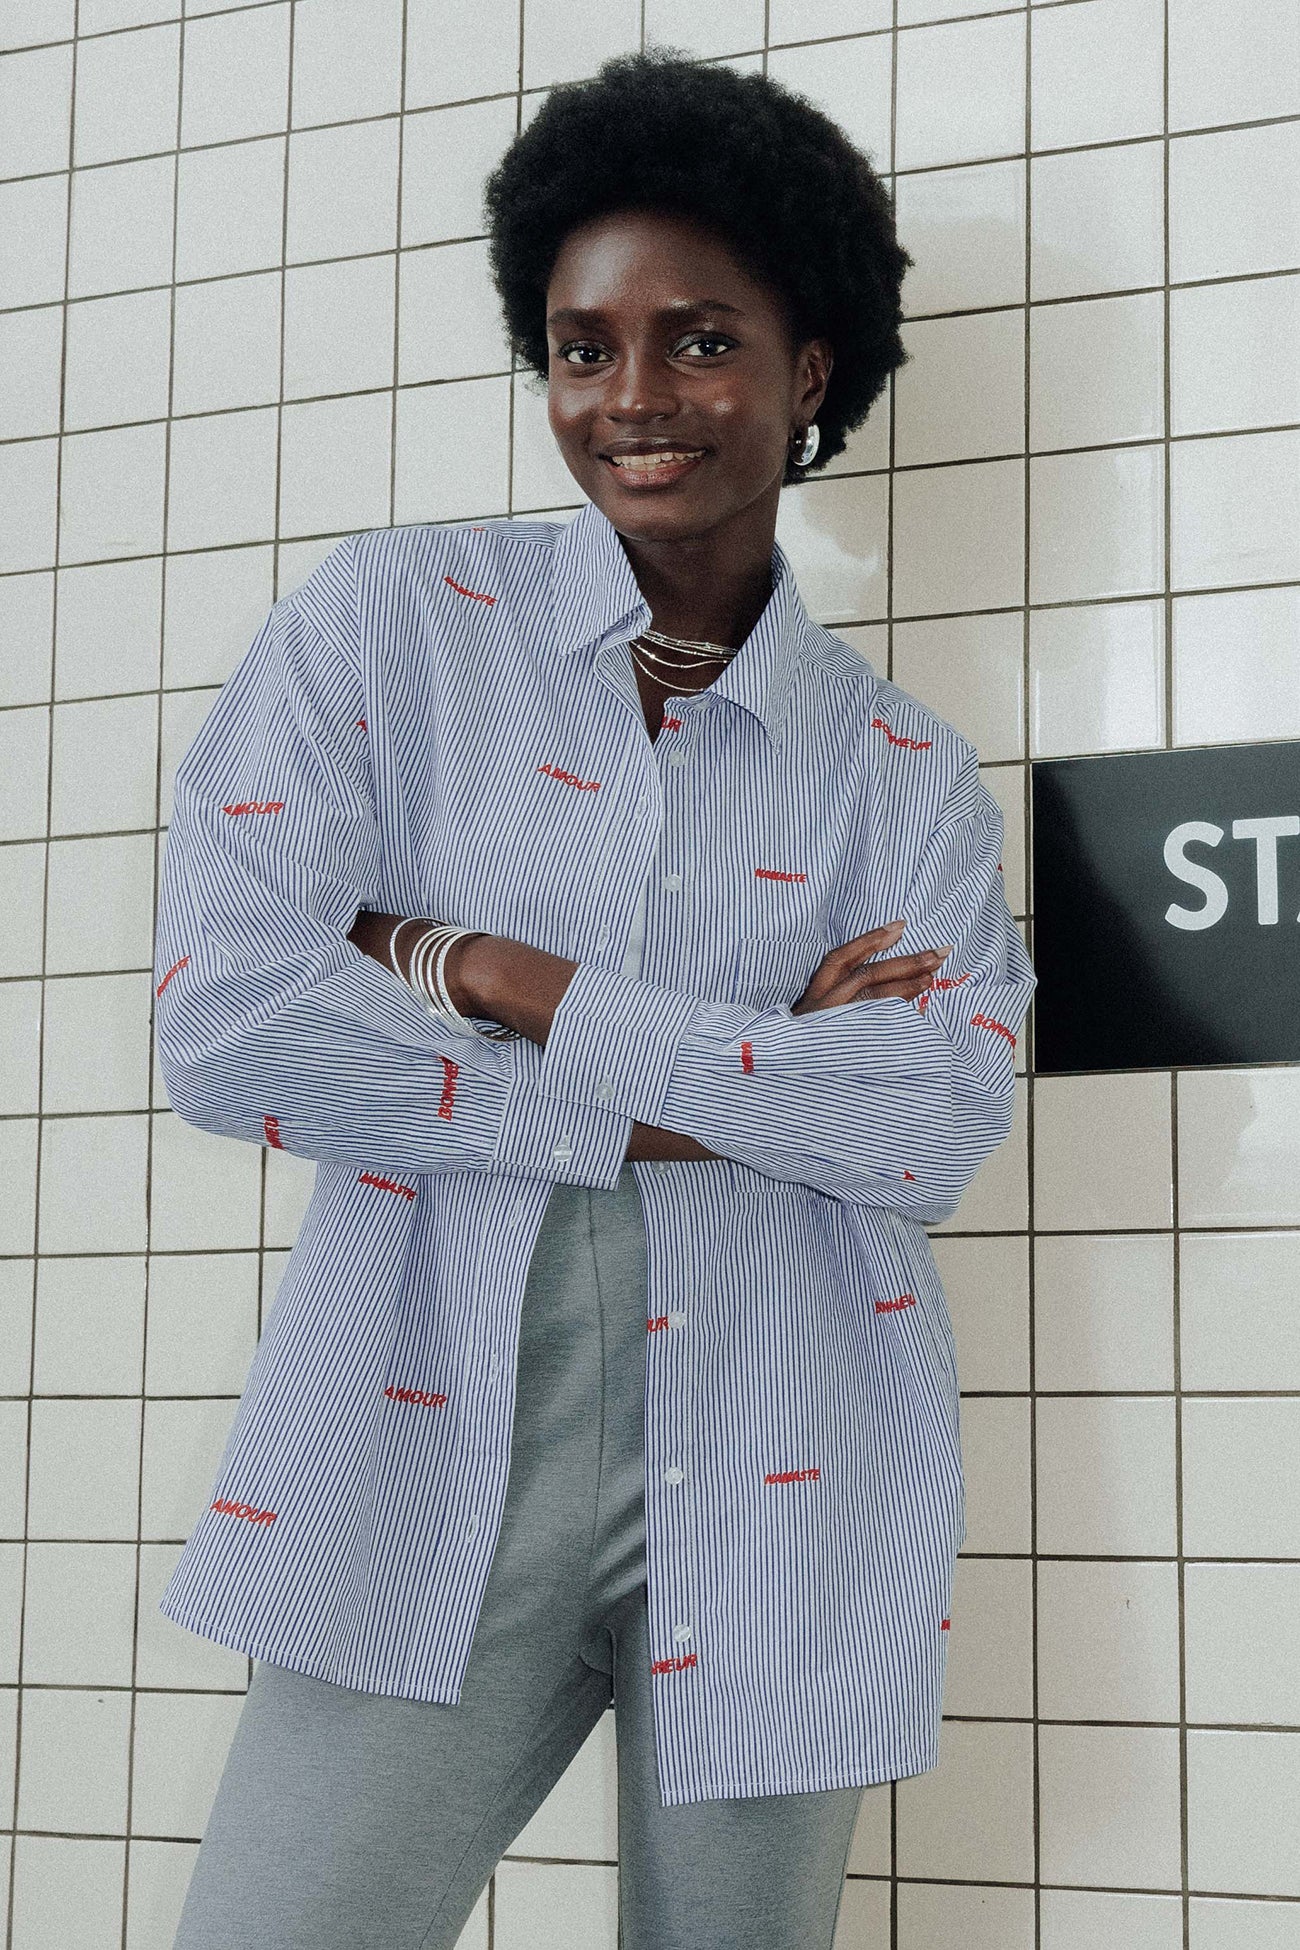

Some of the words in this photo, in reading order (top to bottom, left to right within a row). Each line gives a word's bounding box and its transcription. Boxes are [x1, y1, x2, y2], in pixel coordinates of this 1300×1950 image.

[538, 764, 600, 791] AMOUR
[223, 802, 283, 816] AMOUR
[755, 869, 806, 883] NAMASTE
[1163, 815, 1300, 931] ST
[359, 1173, 415, 1200] NAMASTE
[384, 1386, 446, 1407] AMOUR
[765, 1469, 820, 1485] NAMASTE
[210, 1498, 276, 1527] AMOUR
